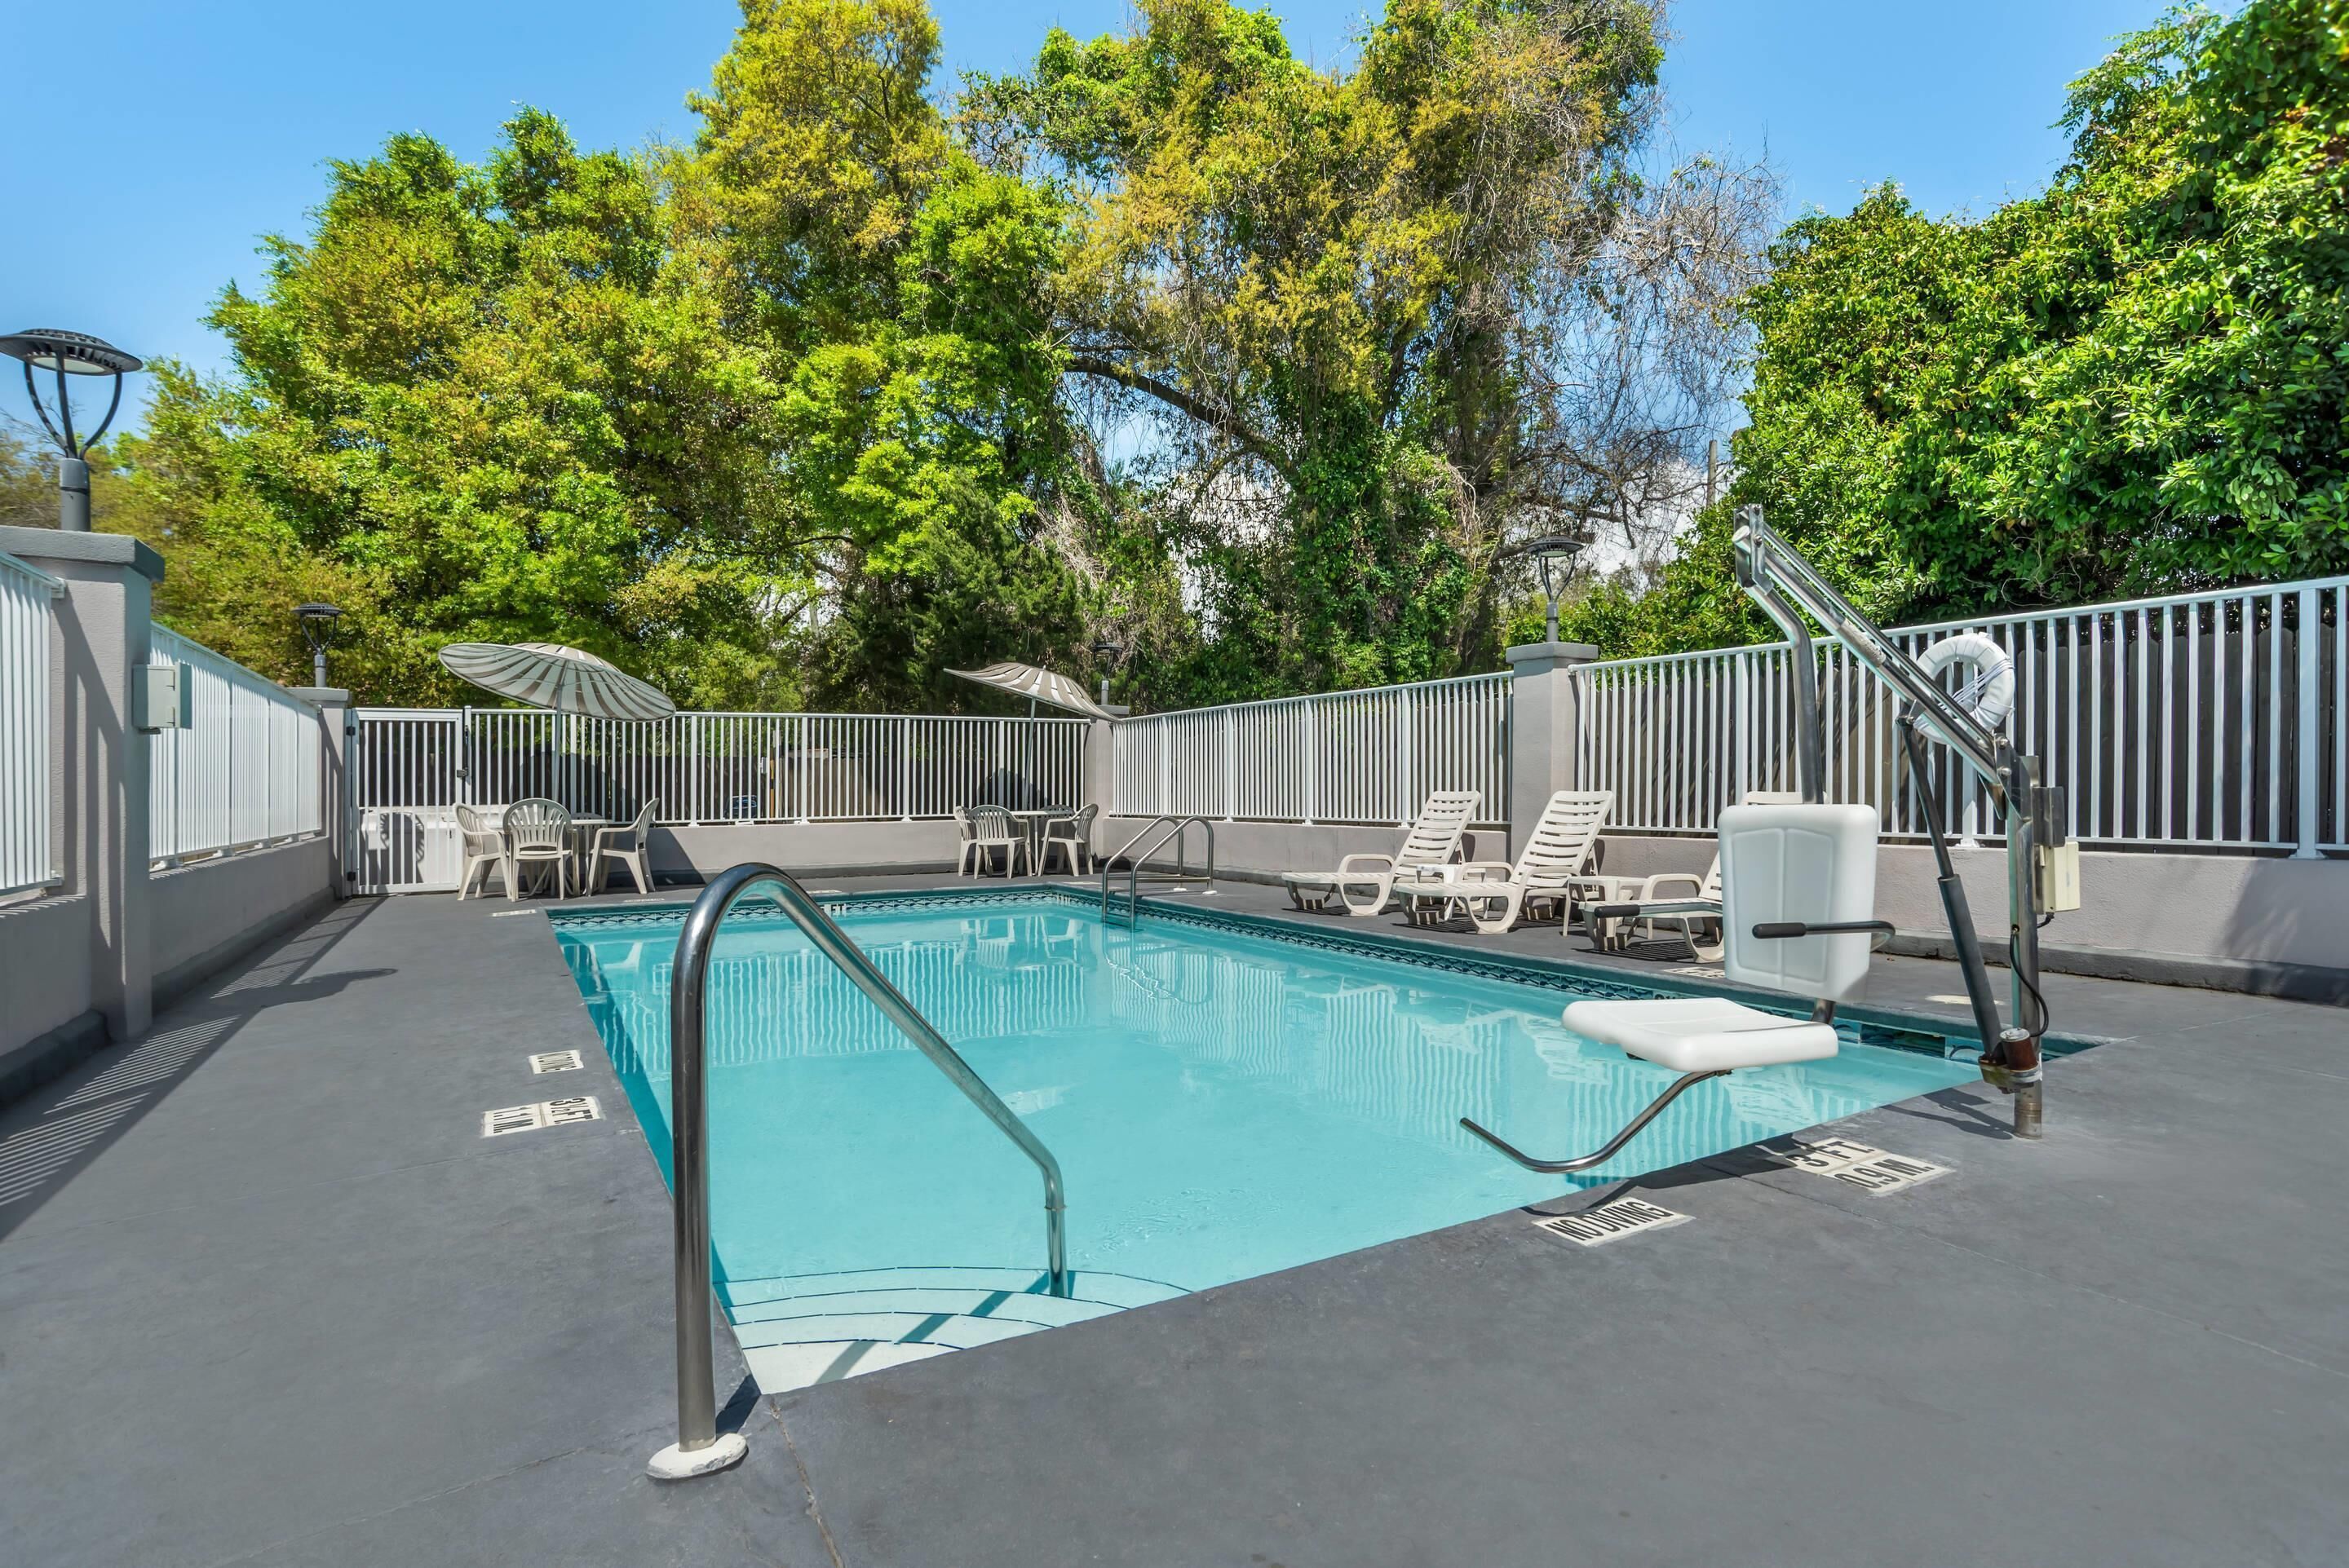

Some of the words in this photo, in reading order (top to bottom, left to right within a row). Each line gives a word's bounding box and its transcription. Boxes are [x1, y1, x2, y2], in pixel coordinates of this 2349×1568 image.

[493, 1107, 533, 1120] 1.1
[493, 1118, 533, 1133] M.
[1785, 1154, 1829, 1168] 3
[1814, 1141, 1875, 1159] FT.
[1834, 1167, 1900, 1189] 0.9
[1872, 1159, 1935, 1176] M.
[1545, 1219, 1604, 1241] NO
[1577, 1201, 1674, 1233] DIVING
